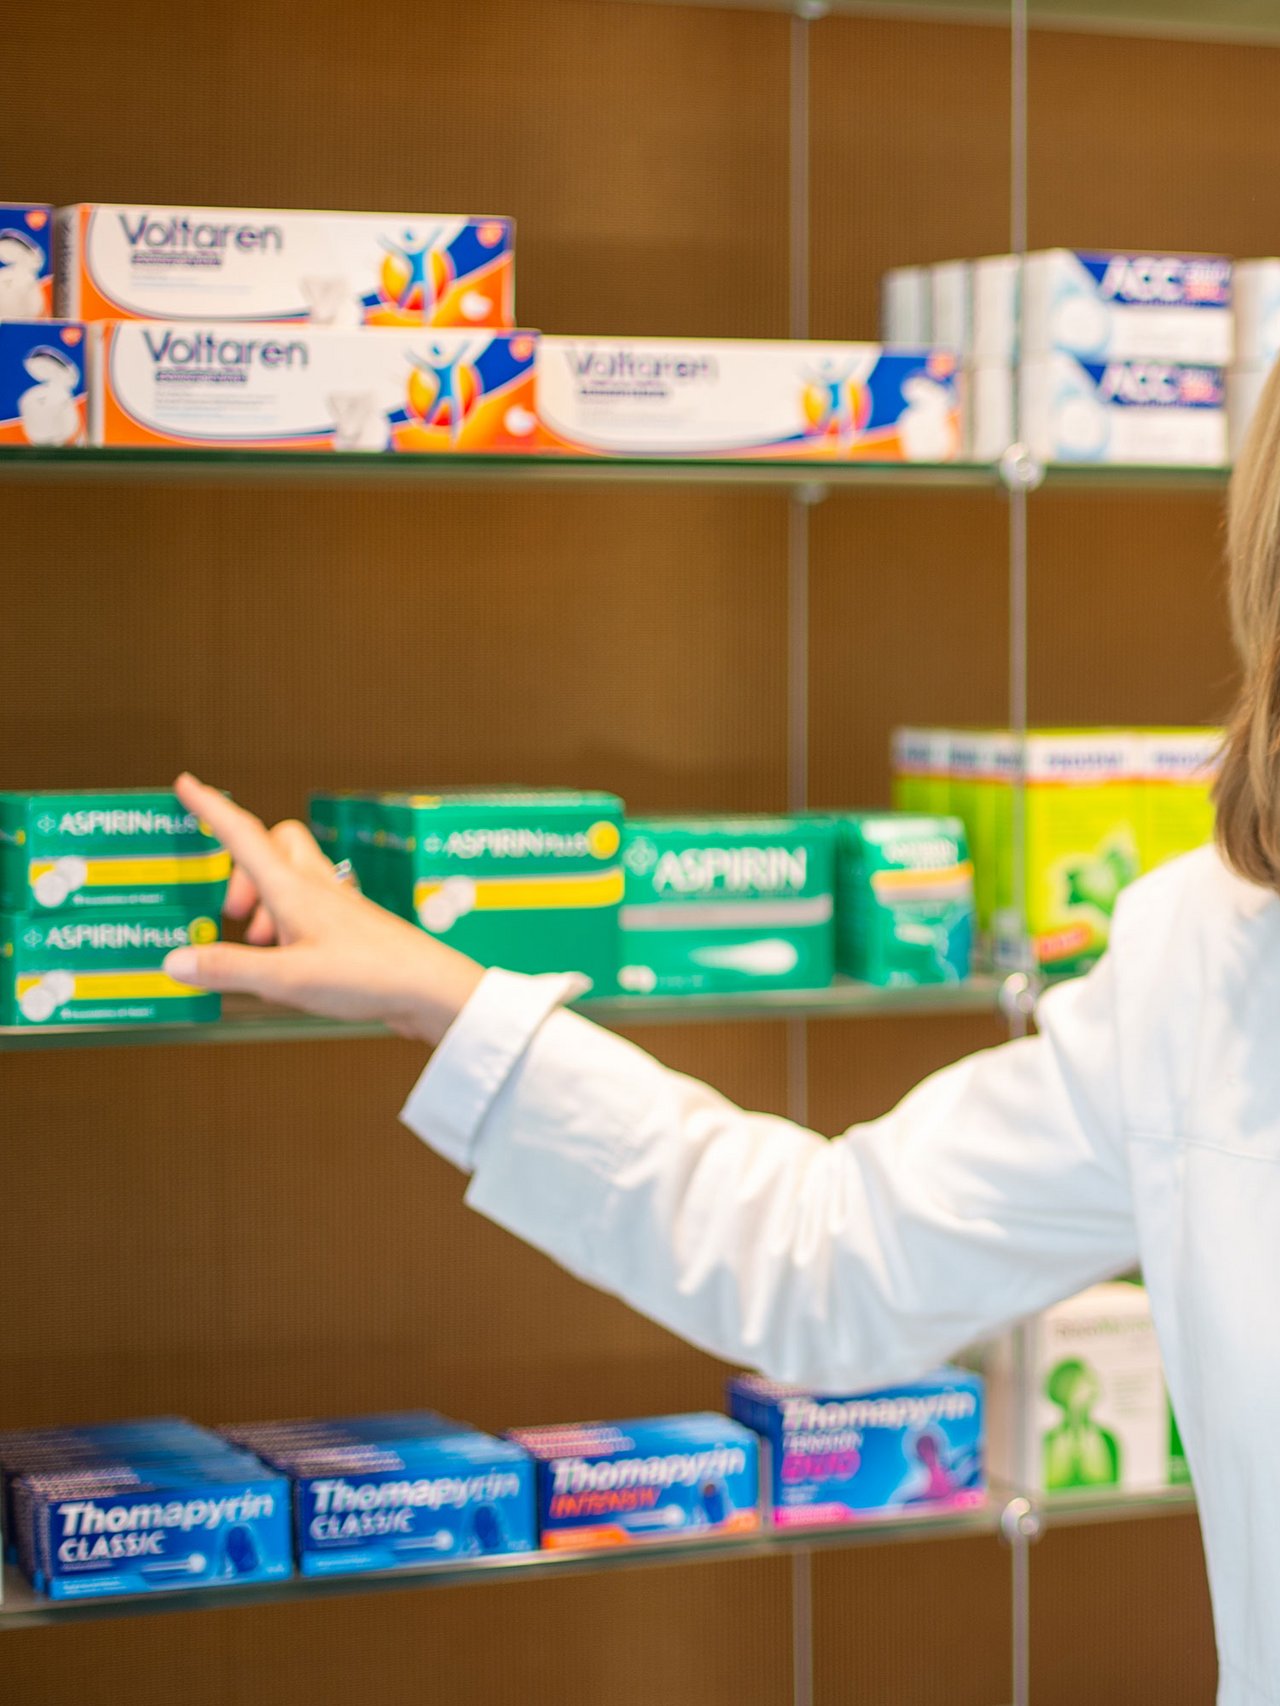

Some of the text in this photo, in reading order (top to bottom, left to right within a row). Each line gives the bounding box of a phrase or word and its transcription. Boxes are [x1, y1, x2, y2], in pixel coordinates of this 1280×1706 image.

[118, 213, 284, 251] Voltaren
[142, 330, 309, 369] Voltaren
[59, 809, 153, 837] ASPIRIN
[652, 845, 807, 893] ASPIRIN
[46, 922, 141, 950] ASPIRIN
[778, 1386, 976, 1432] Thomapyrin
[550, 1442, 746, 1495] Thomapyrin
[309, 1467, 520, 1514] Thomapyrin
[57, 1489, 274, 1537] Thomapyrin
[309, 1507, 415, 1540] CLASSIC
[57, 1530, 168, 1563] CLASSIC
